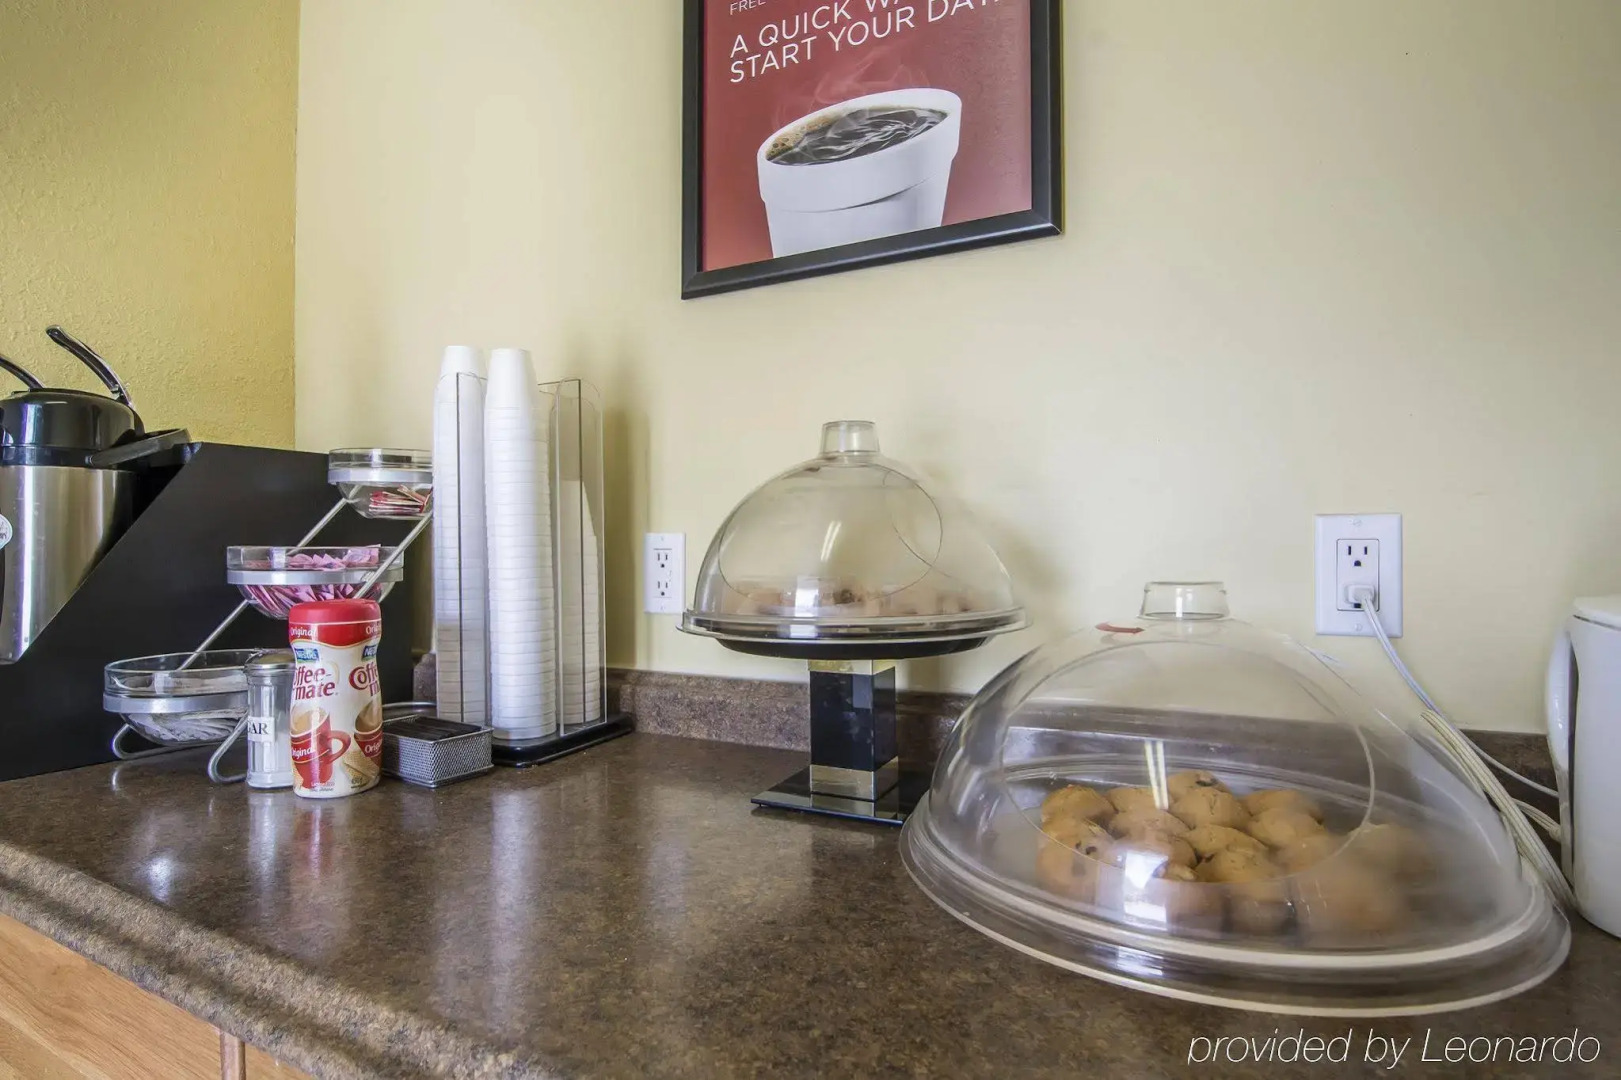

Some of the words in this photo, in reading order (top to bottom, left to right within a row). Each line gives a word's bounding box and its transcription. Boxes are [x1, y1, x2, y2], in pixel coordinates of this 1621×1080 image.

[730, 34, 749, 58] A
[758, 6, 852, 47] QUICK
[730, 36, 818, 83] START
[828, 6, 915, 51] YOUR
[248, 721, 268, 735] AR
